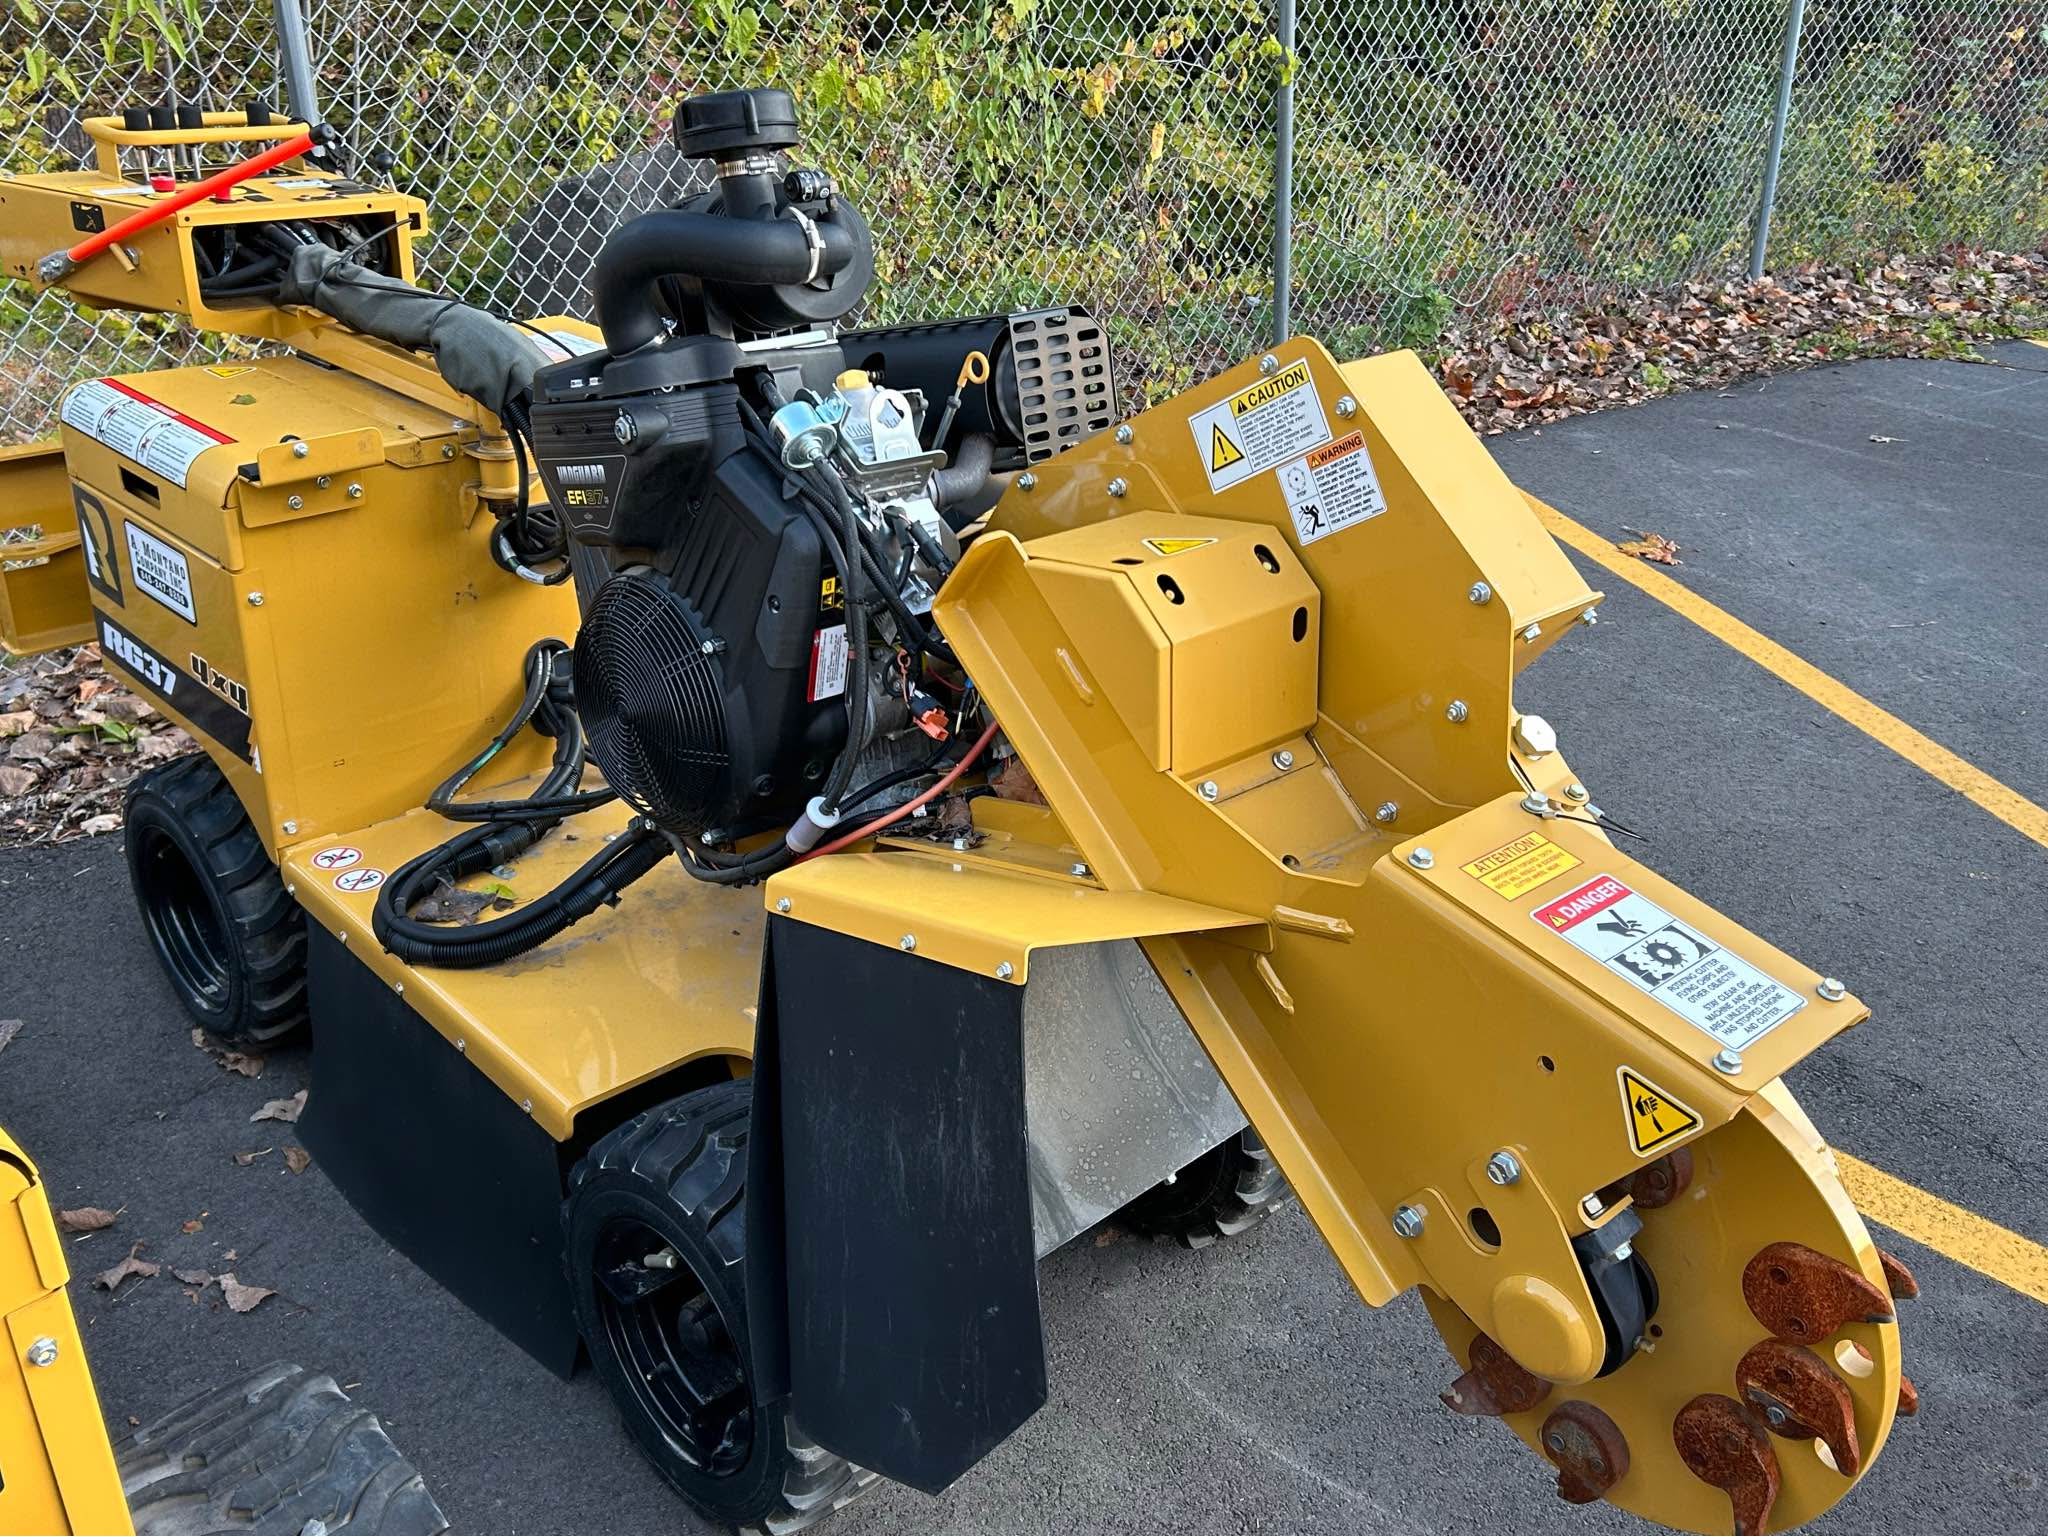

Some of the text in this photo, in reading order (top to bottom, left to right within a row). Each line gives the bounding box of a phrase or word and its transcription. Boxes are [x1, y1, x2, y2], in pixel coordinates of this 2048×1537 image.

[1248, 368, 1304, 407] CAUTION
[1318, 436, 1362, 462] WARNING
[556, 464, 607, 484] VANGUARD
[142, 541, 186, 580] MONTANO
[103, 621, 177, 696] RG37
[1474, 837, 1539, 873] ATTENTION!
[1558, 881, 1623, 919] DANGER
[1667, 958, 1720, 992] ROTATING CUTTER
[1676, 964, 1729, 999] FLYING CHIPS AND
[1687, 988, 1710, 1003] OTHER
[1703, 980, 1746, 1011] STAY CLEAR OF
[1705, 982, 1763, 1021] MACHINE AND WORK
[1709, 984, 1777, 1032] AREA UNLESS OPERATOR
[1721, 992, 1785, 1035] HAS STOPPED ENGINE
[1743, 1022, 1759, 1033] AND
